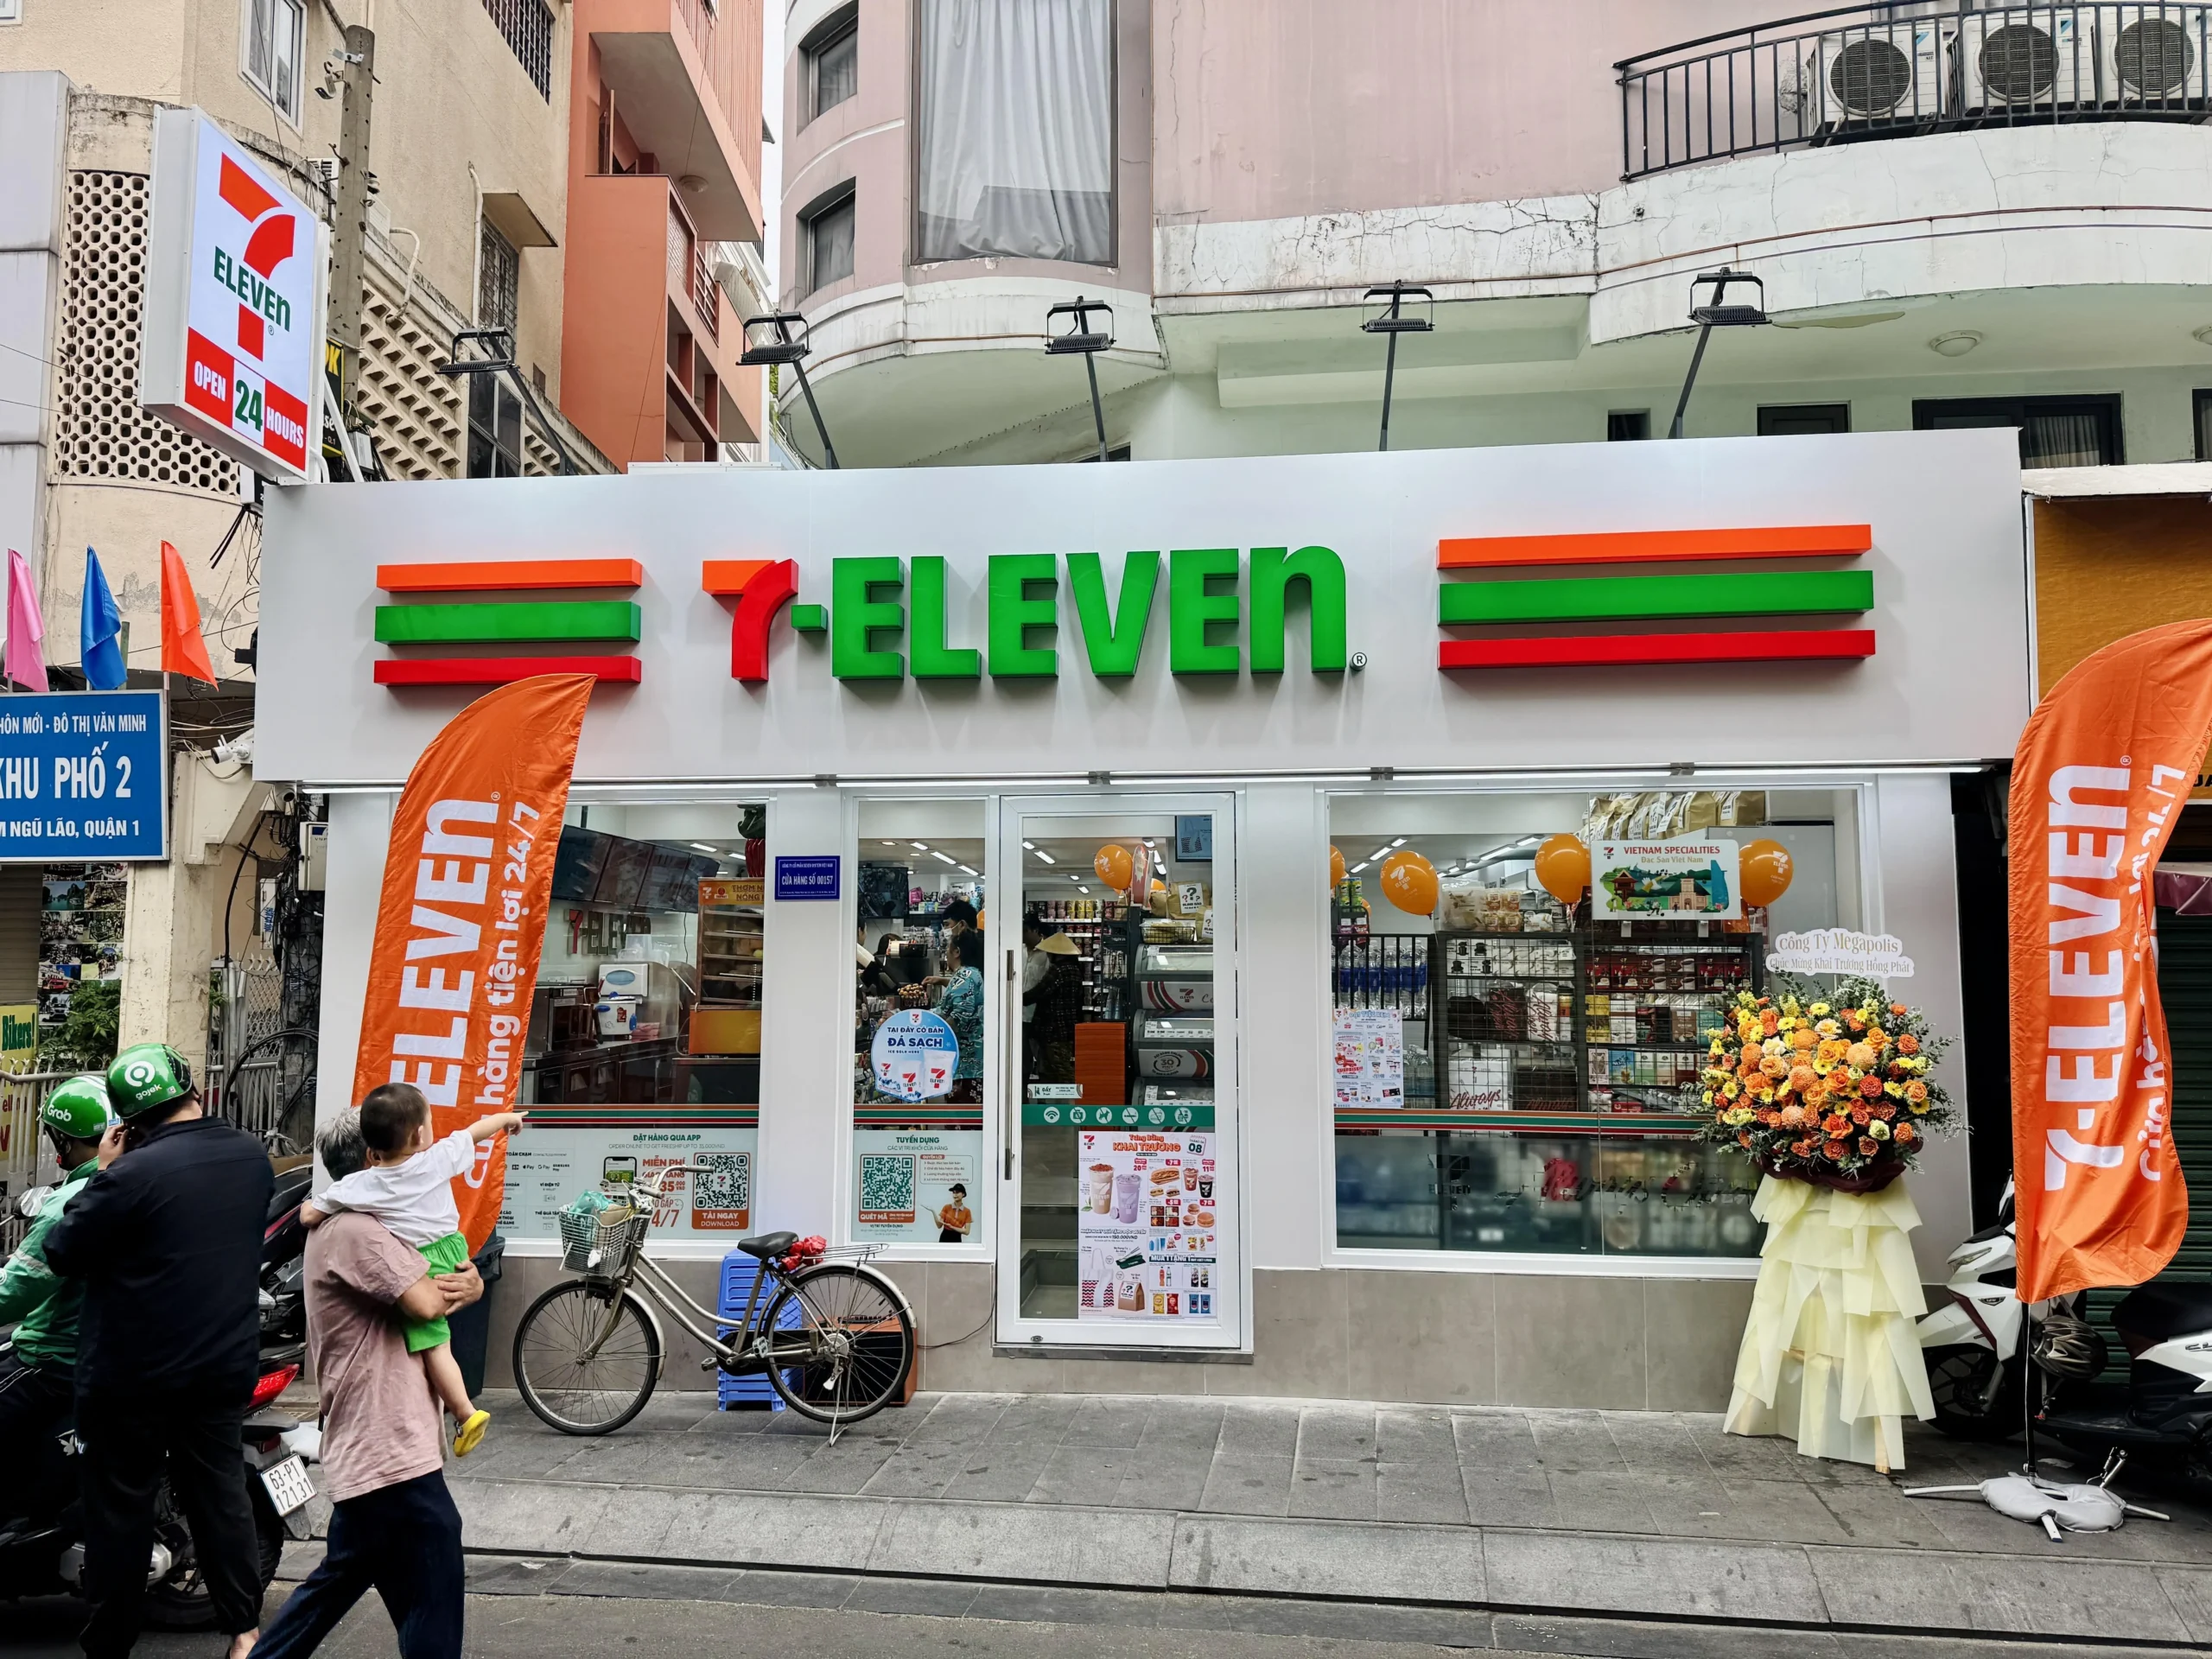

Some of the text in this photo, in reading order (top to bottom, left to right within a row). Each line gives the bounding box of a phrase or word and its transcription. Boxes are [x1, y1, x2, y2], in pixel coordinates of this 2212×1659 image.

[194, 360, 304, 448] OPEN 24 HOURS
[23, 712, 43, 734] MỚI
[54, 712, 68, 734] ĐÔ
[73, 715, 90, 736] THỊ
[93, 711, 116, 733] VĂN
[118, 714, 147, 732] MINH
[54, 741, 109, 798] PHỐ
[116, 755, 131, 798] 2
[10, 817, 41, 836] NGŨ
[47, 817, 79, 838] LÃO,
[85, 817, 127, 839] QUẬN
[132, 820, 139, 836] 1
[1664, 846, 1720, 855] SPECIALITIES
[782, 872, 834, 885] CỬA HÀNG SỐ 00157
[476, 801, 540, 1105] hàng tiện lợi 24/7
[1779, 932, 1898, 955] Công Ty Megapolis
[2, 1013, 35, 1052] Bikers!
[908, 1038, 943, 1049] SẠCH
[136, 1084, 162, 1101] gojek
[47, 1104, 72, 1122] Grab
[1188, 1143, 1203, 1154] 08
[268, 1460, 300, 1490] 63-P1
[276, 1477, 313, 1510] 121.31
